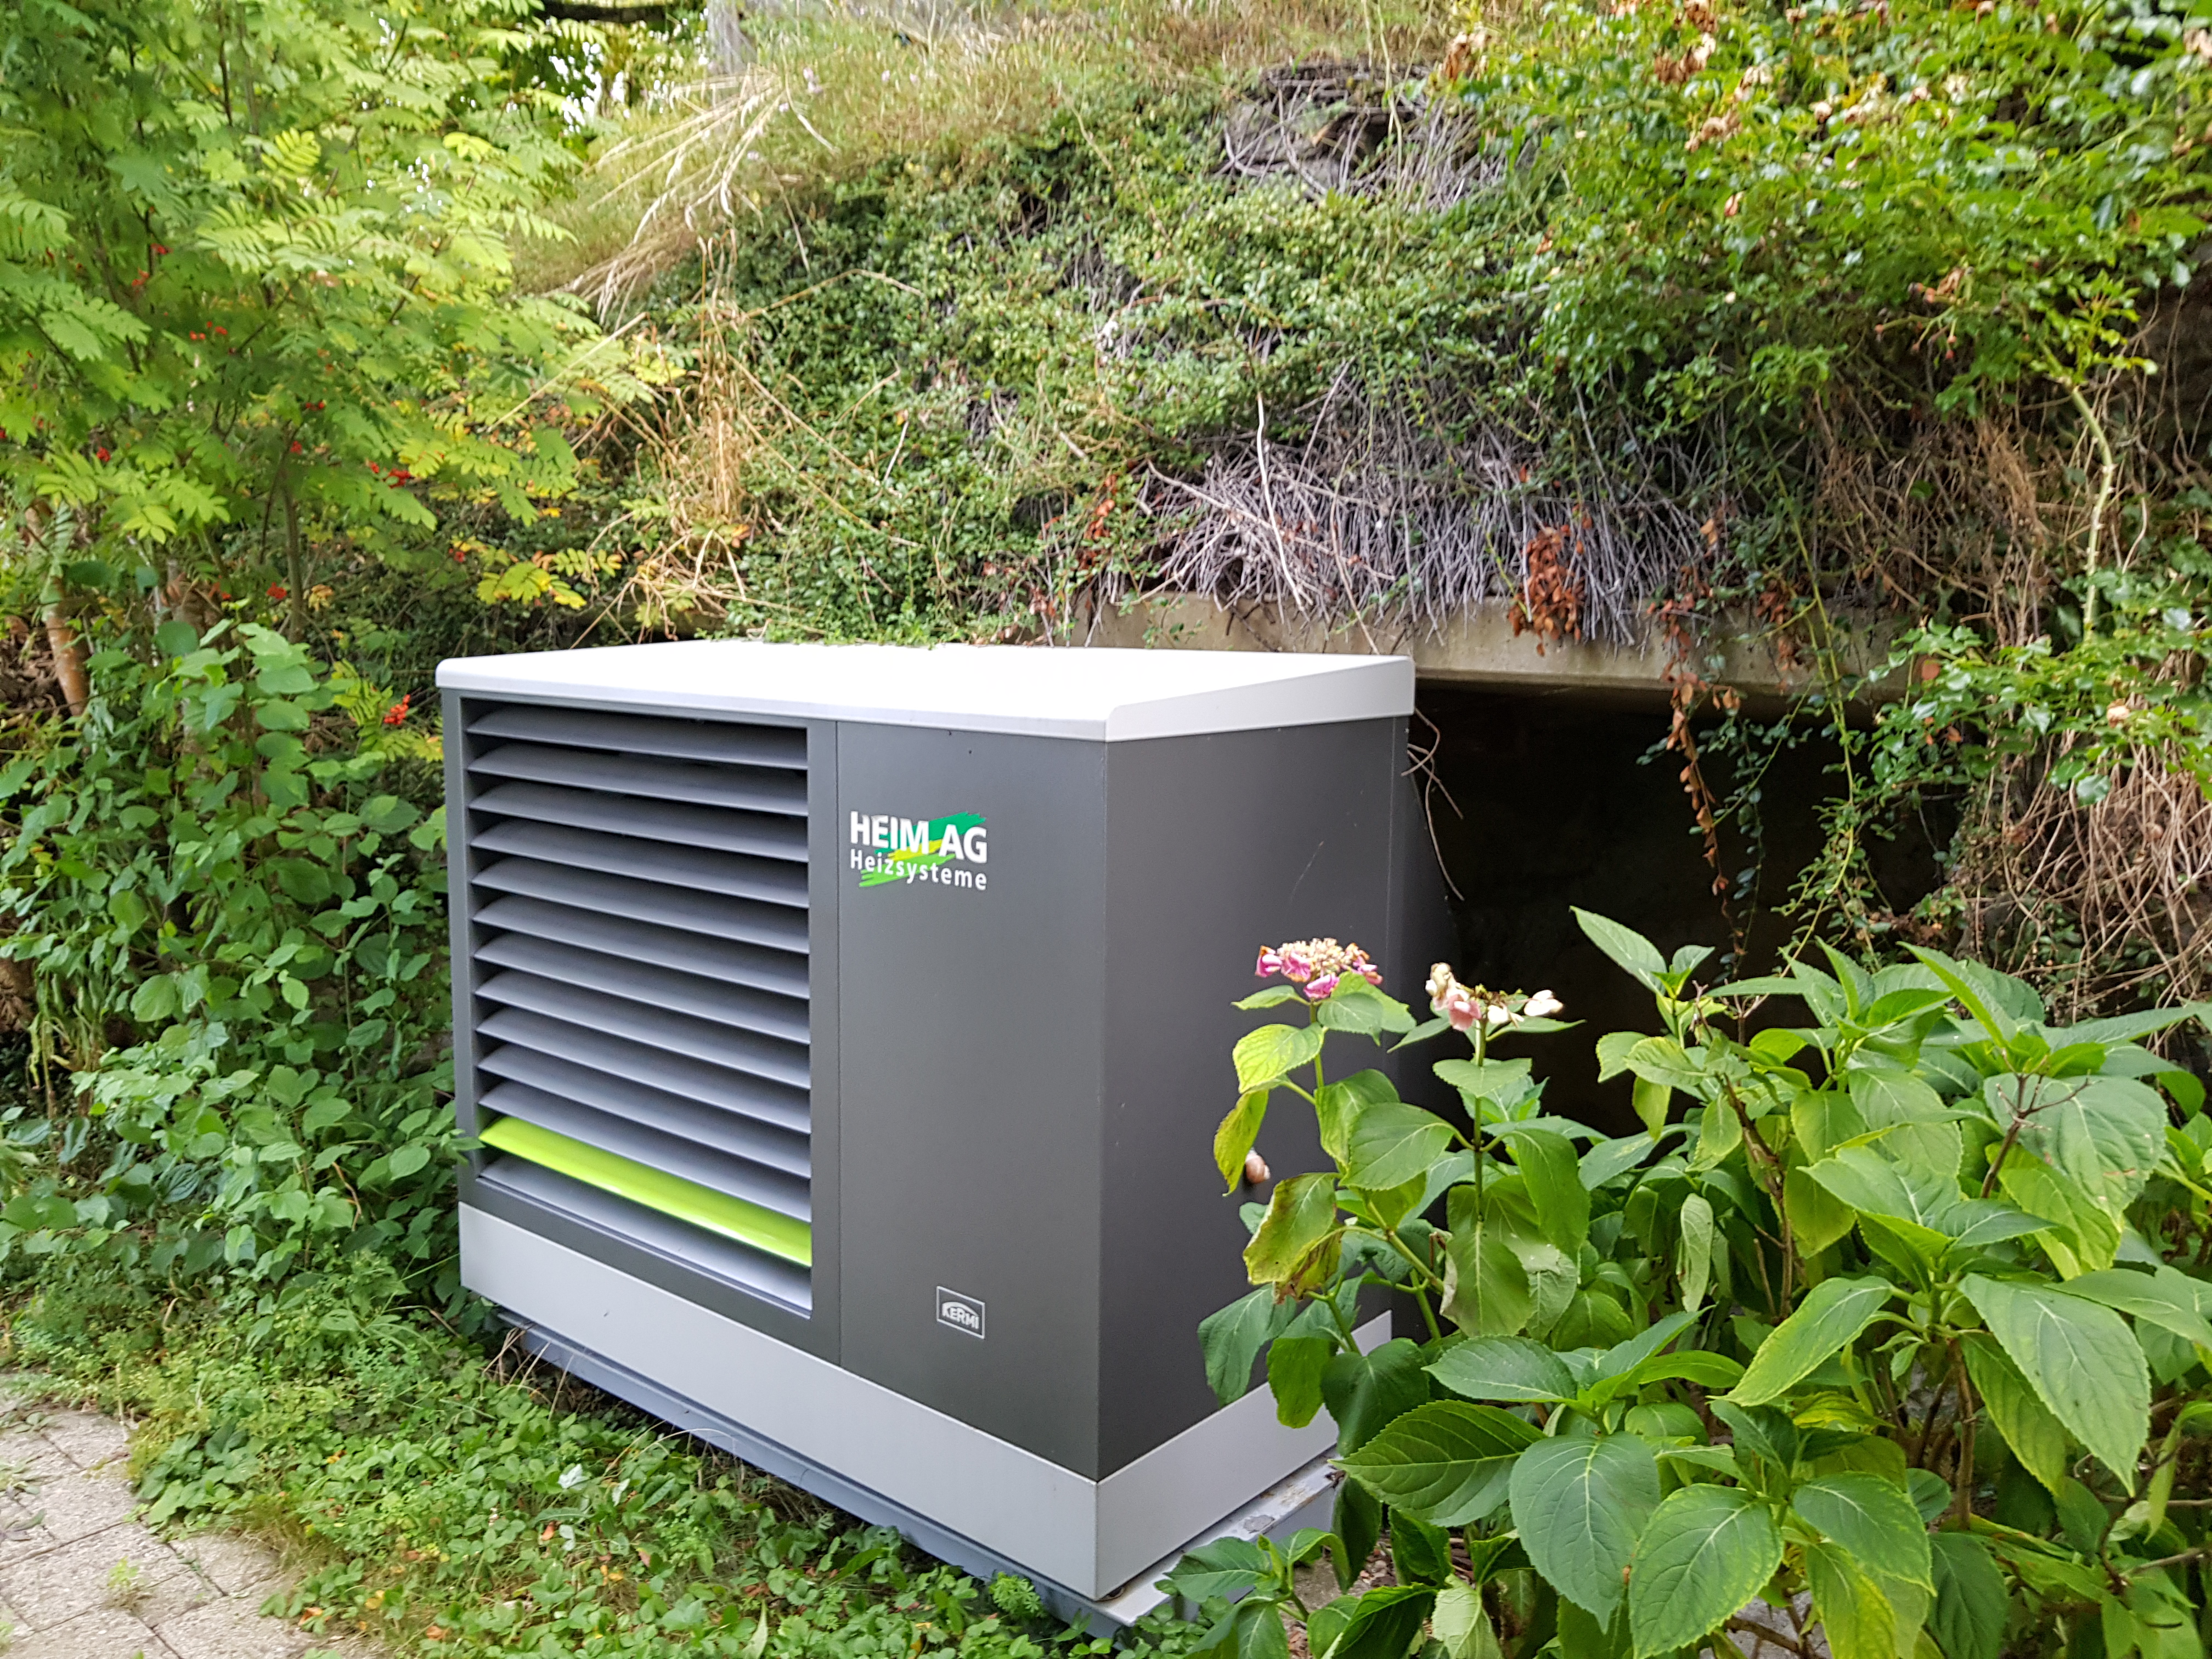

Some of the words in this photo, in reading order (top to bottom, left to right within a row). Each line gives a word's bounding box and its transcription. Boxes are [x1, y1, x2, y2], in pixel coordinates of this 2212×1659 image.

[850, 811, 929, 855] HEIM
[939, 823, 988, 864] AG
[850, 849, 987, 891] Heizsysteme
[941, 1301, 979, 1329] KERMI
